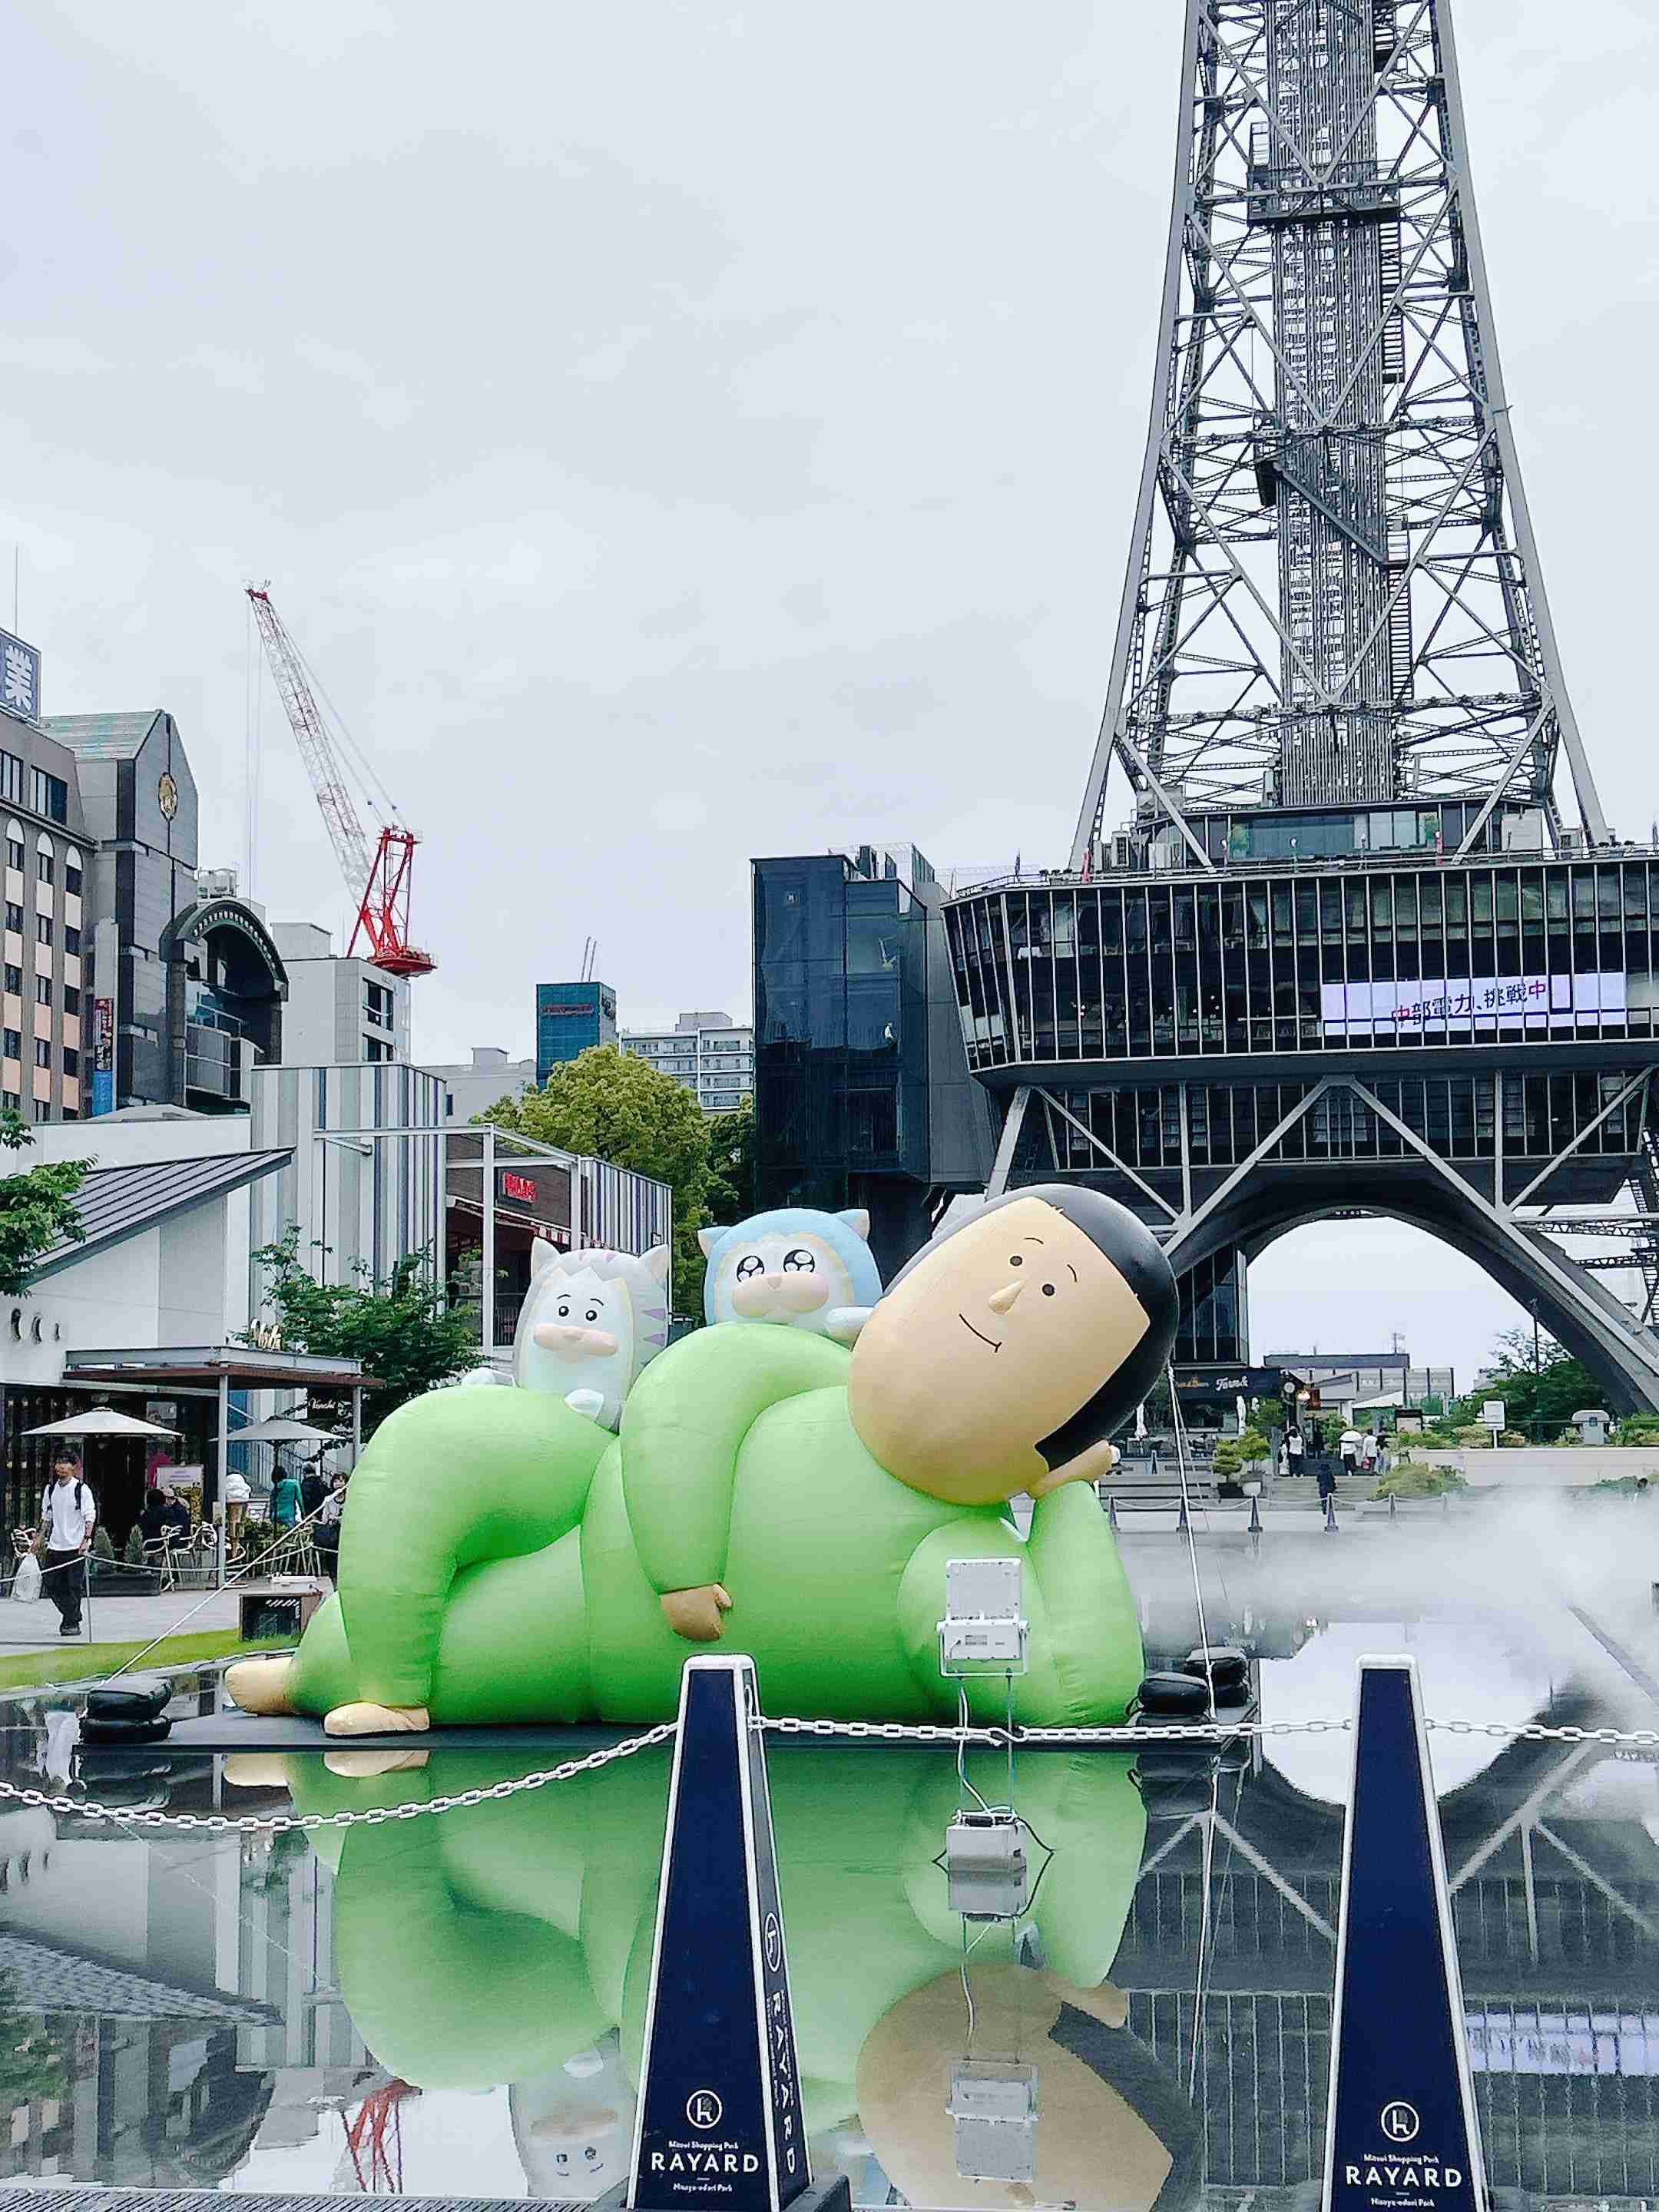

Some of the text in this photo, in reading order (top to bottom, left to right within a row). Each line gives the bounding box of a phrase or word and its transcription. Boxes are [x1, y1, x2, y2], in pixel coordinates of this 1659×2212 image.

[5, 644, 31, 711] 業
[1391, 979, 1546, 1028] 中部電力、挑戦中
[773, 1991, 796, 2174] RAYARD
[691, 2141, 723, 2151] Shopping
[651, 2152, 759, 2173] RAYARD
[1388, 2154, 1422, 2165] Shopping
[1423, 2155, 1439, 2164] Park
[1346, 2165, 1462, 2187] RAYARD
